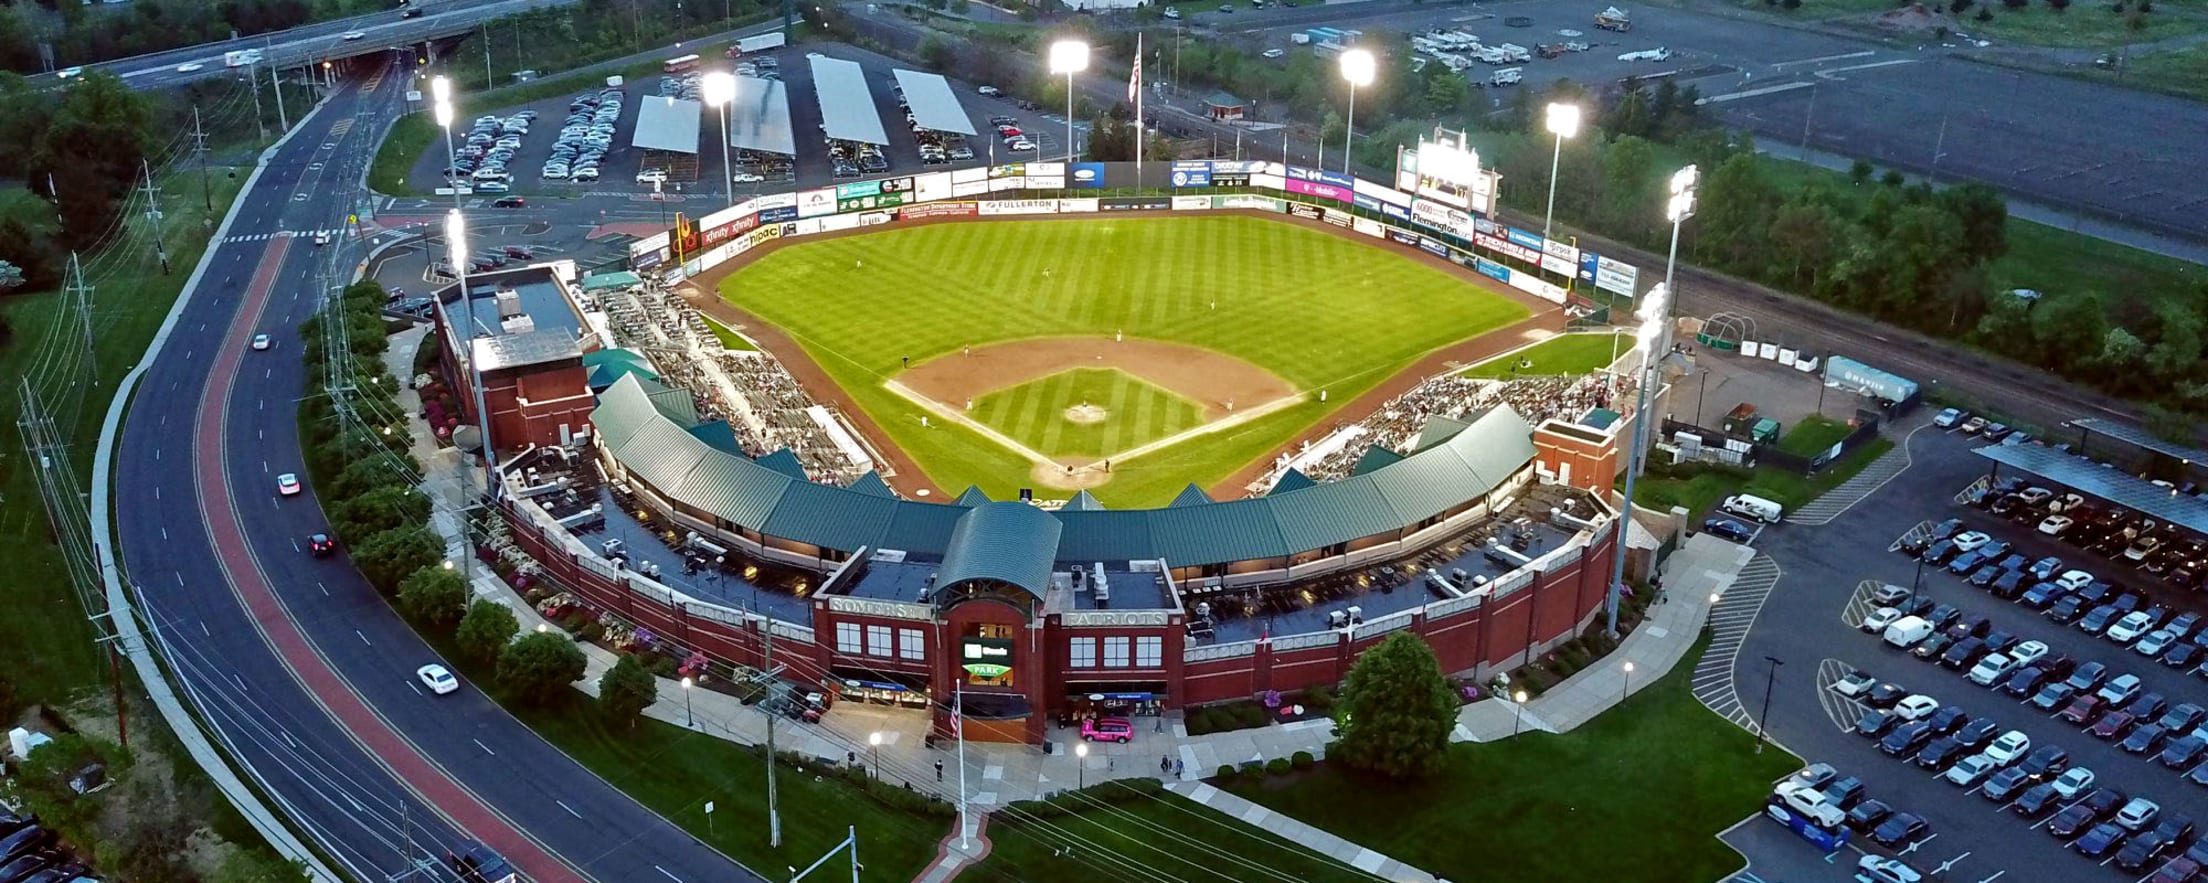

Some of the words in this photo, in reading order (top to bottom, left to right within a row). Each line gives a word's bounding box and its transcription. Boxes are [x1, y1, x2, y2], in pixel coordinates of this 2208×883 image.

[998, 200, 1052, 209] FULLERTON
[832, 597, 930, 619] SOMERSET
[1066, 611, 1164, 626] PATRIOTS
[974, 666, 999, 675] PARK
